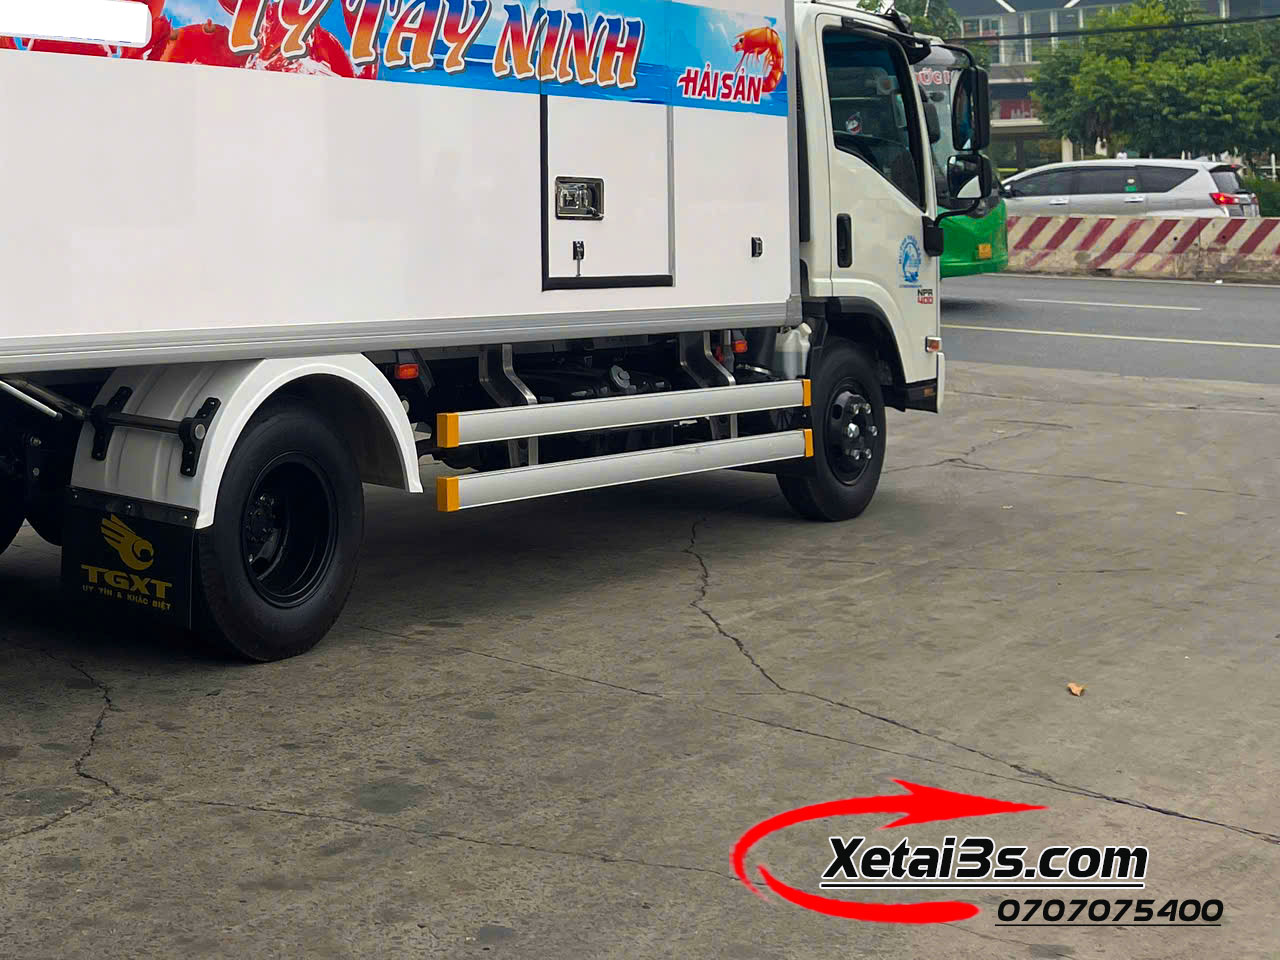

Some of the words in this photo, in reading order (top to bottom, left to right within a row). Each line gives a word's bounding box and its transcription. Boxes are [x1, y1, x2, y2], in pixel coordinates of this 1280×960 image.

[492, 0, 646, 91] NINH
[677, 61, 720, 100] HẢI
[720, 67, 763, 104] SẢN
[917, 288, 933, 297] NPR
[81, 563, 173, 599] TGXT
